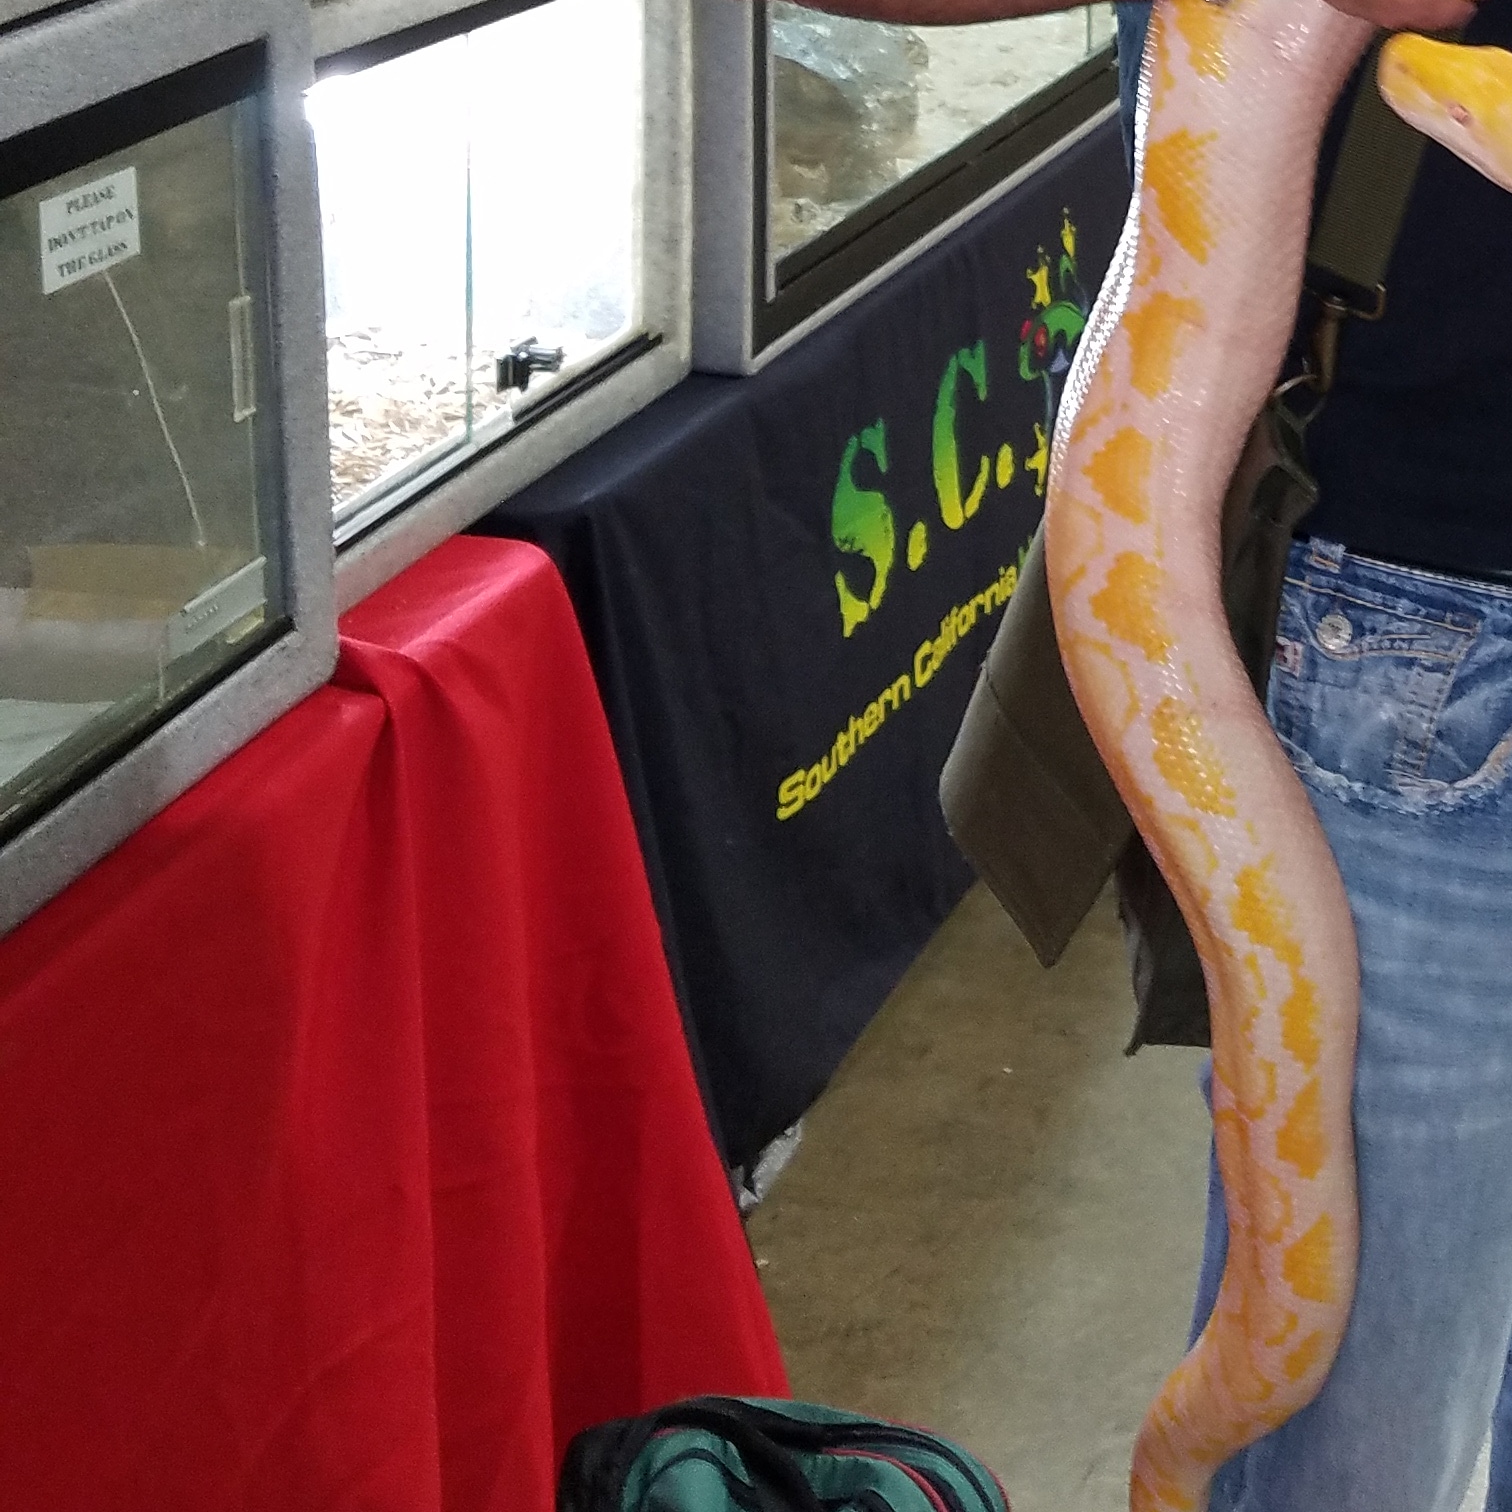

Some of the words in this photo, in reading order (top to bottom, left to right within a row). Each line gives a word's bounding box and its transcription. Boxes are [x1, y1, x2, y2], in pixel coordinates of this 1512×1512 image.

[66, 184, 115, 215] PLEASE
[58, 255, 86, 278] THE
[775, 674, 911, 821] Southern
[914, 565, 1018, 688] California
